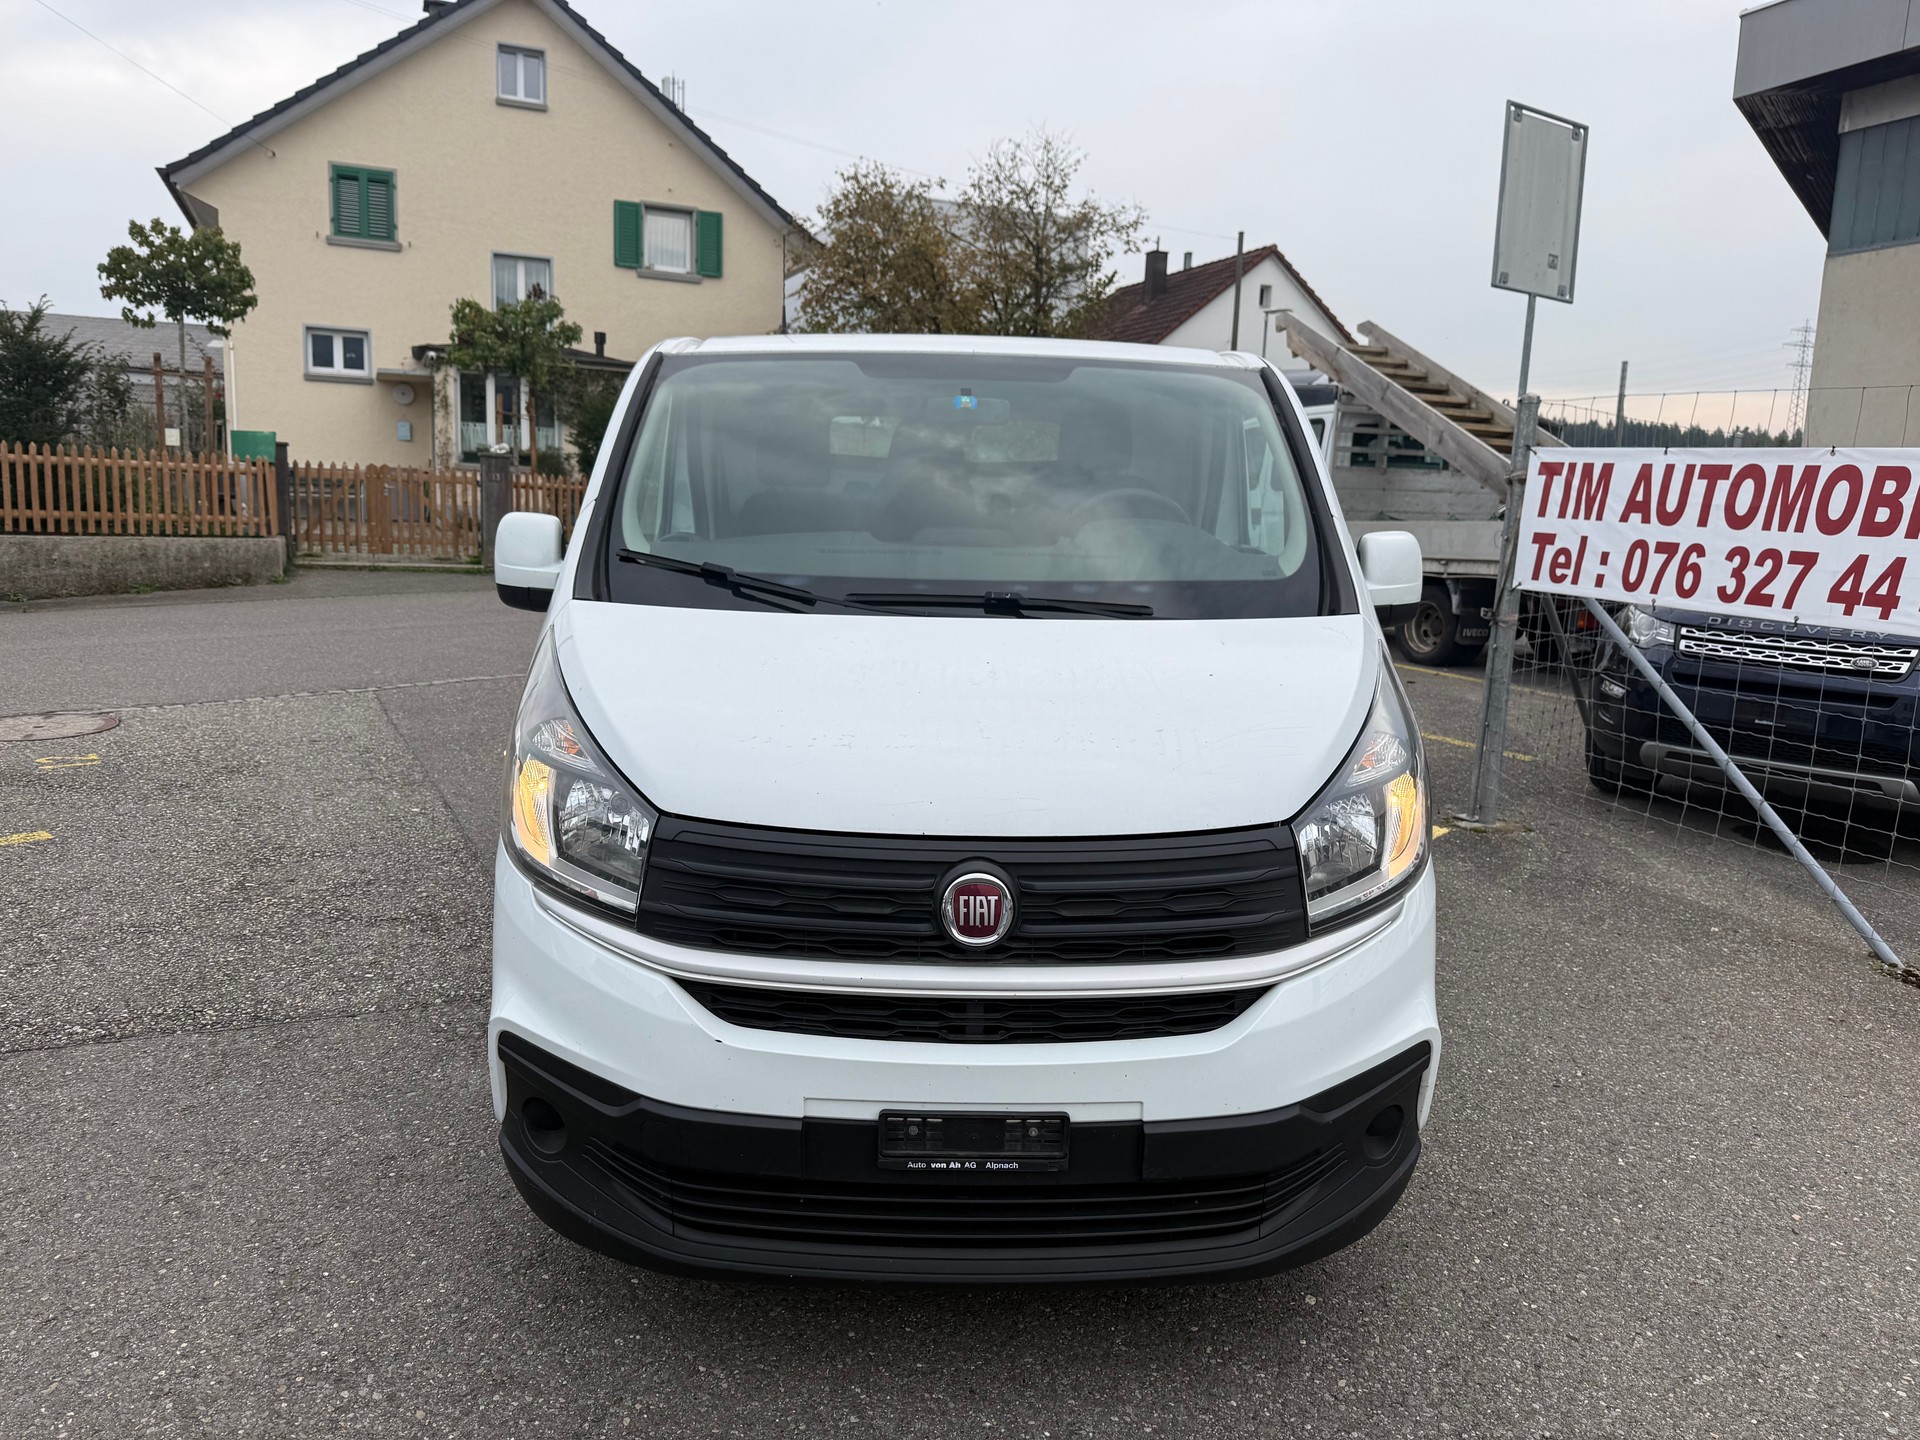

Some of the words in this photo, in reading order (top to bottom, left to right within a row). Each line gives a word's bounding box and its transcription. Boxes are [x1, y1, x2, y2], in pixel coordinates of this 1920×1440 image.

[1537, 461, 1615, 521] TIM
[1622, 539, 1706, 599] 076
[1717, 546, 1820, 610] 327
[1827, 554, 1907, 620] 44
[1462, 628, 1489, 637] IVECO
[1708, 616, 1890, 640] DISCOVERY
[959, 895, 999, 927] FIAT
[907, 1161, 927, 1169] Auto
[949, 1161, 961, 1169] Ah
[964, 1161, 977, 1169] AG
[985, 1161, 1019, 1170] Alpnach
